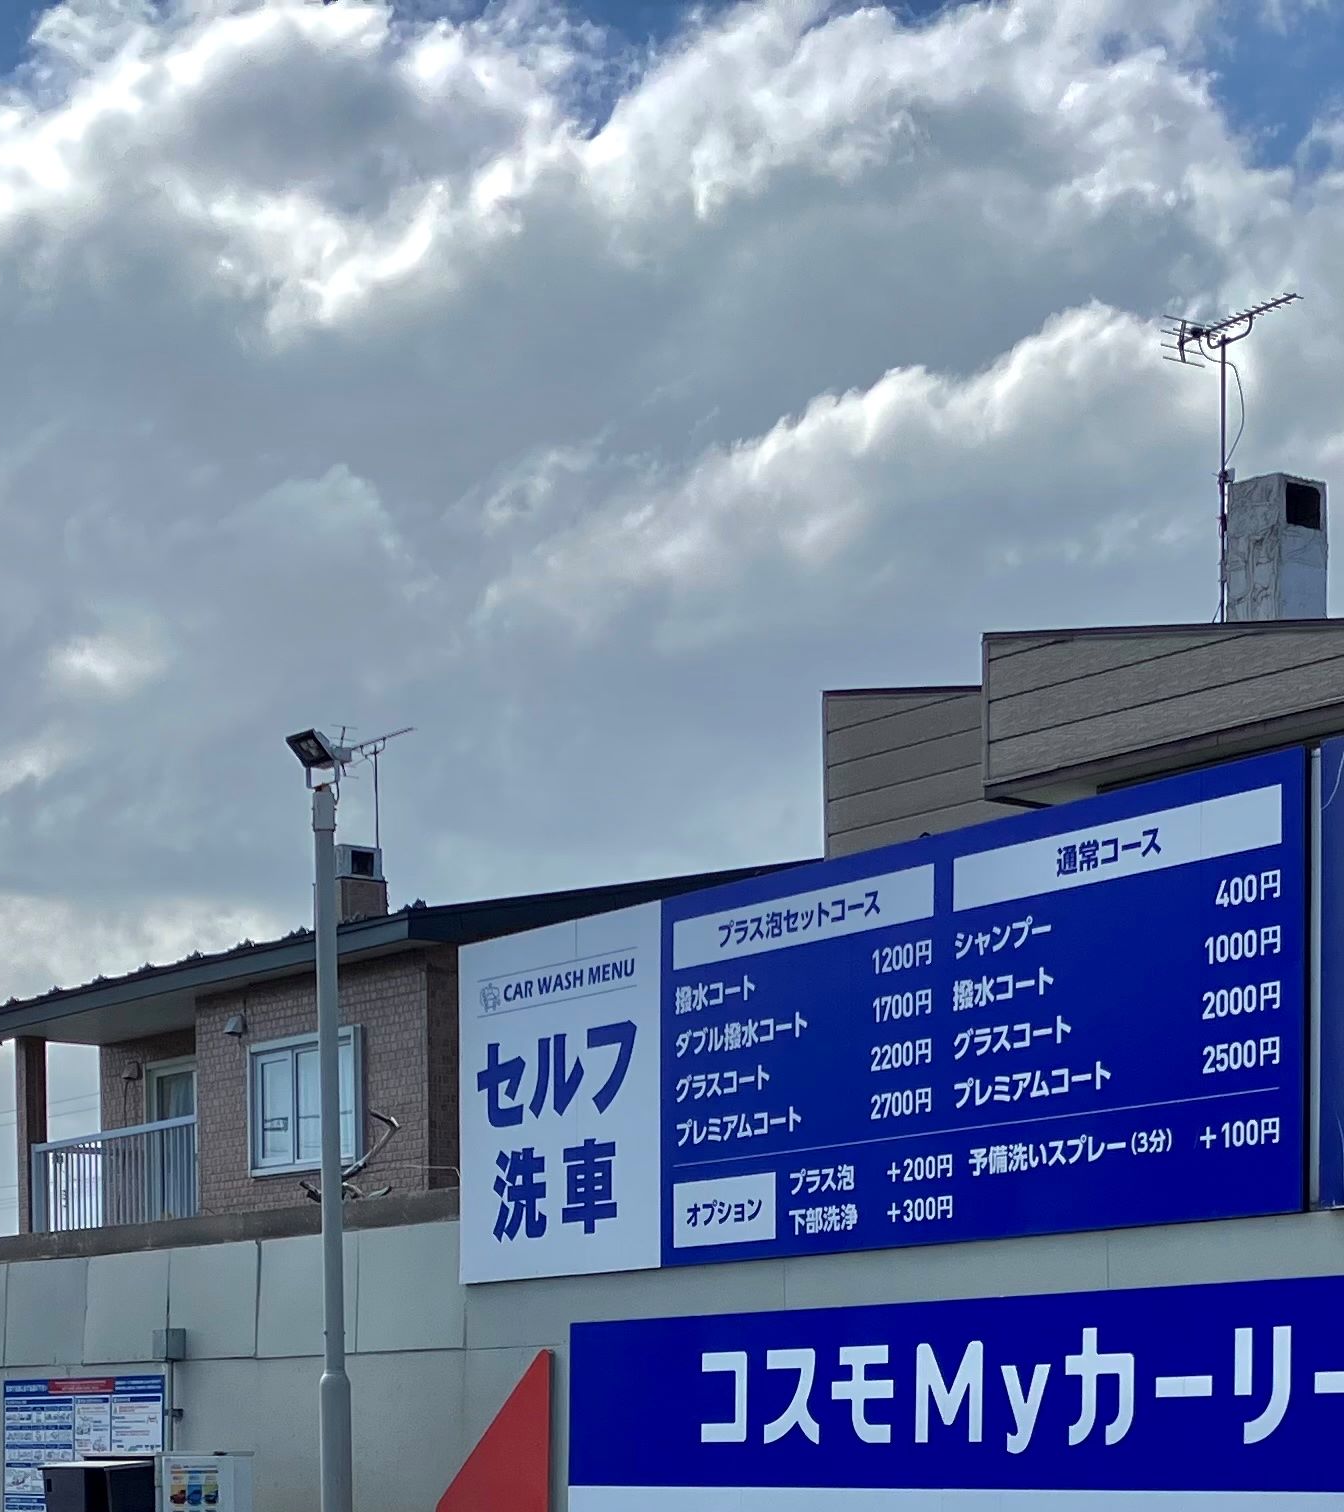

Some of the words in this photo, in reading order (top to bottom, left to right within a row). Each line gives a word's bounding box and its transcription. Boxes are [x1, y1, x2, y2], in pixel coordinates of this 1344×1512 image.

[1056, 827, 1161, 877] 通常コース
[717, 889, 881, 948] プラス泡セットコース
[955, 916, 1051, 959] シャンプー
[1216, 870, 1280, 907] 400円
[504, 981, 533, 1001] CAR
[538, 969, 583, 995] WASH
[588, 958, 634, 985] MENU
[676, 975, 755, 1014] 撥水コート
[873, 940, 931, 974] 1200円
[953, 967, 1053, 1011] 撥水コート
[1205, 926, 1280, 964] 1000円
[676, 1010, 807, 1057] ダブル撥水コート
[873, 989, 931, 1022] 1700円
[954, 1016, 1071, 1059] グラスコート
[1203, 981, 1280, 1019] 2000円
[477, 1020, 637, 1127] セルフ
[676, 1065, 769, 1102] グラスコート
[871, 1039, 931, 1071] 2200円
[954, 1062, 1111, 1109] プレミアムコート
[1203, 1037, 1279, 1074] 2500円
[676, 1107, 802, 1147] プレミアムコート
[871, 1088, 931, 1119] 2700円
[493, 1138, 617, 1243] 洗車
[790, 1164, 854, 1195] プラス泡
[687, 1200, 762, 1227] オプション
[789, 1204, 858, 1235] 下部洗浄
